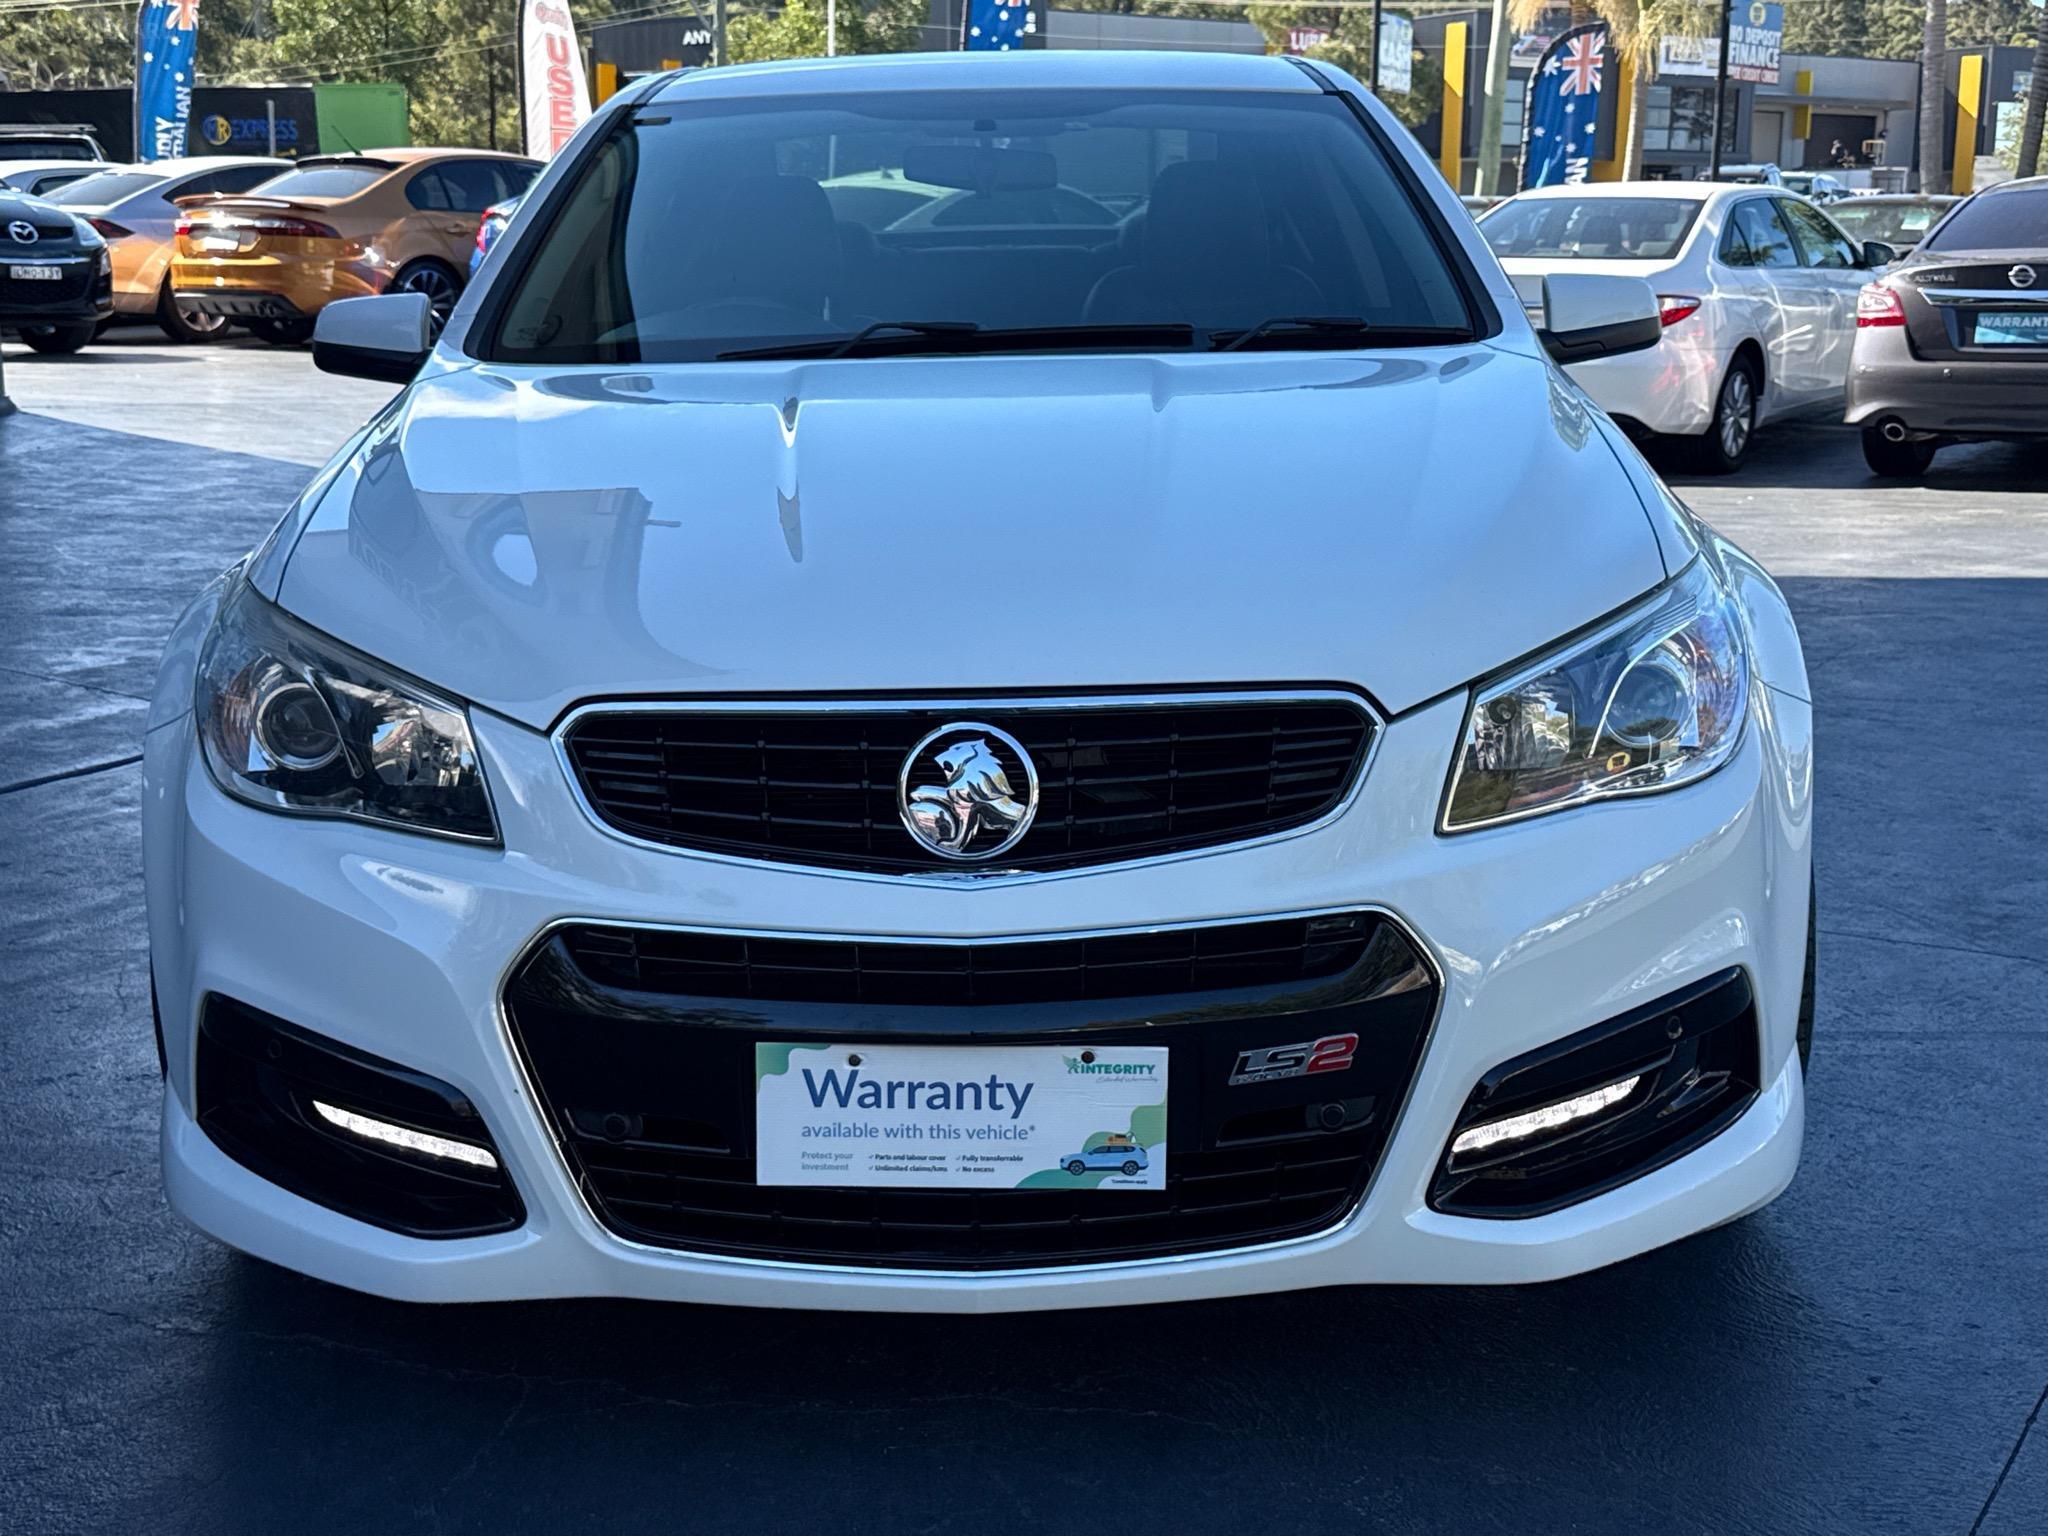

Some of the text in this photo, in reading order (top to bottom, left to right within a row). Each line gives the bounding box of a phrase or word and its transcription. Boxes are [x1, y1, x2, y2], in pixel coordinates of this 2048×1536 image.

[682, 29, 712, 46] ANY
[1729, 25, 1782, 49] NO DEPOSIT
[1728, 41, 1780, 69] FINANCE
[1233, 1032, 1359, 1076] LS2
[1081, 1063, 1156, 1076] INTEGRITY
[801, 1068, 1034, 1119] Warranty
[801, 1122, 880, 1138] available
[884, 1123, 924, 1139] with
[928, 1124, 962, 1140] this
[801, 1151, 854, 1163] Protect your
[875, 1153, 892, 1161] Parts
[906, 1154, 928, 1162] labour
[962, 1154, 979, 1164] Fully
[801, 1163, 849, 1171] investment
[875, 1164, 908, 1172] Unlimited
